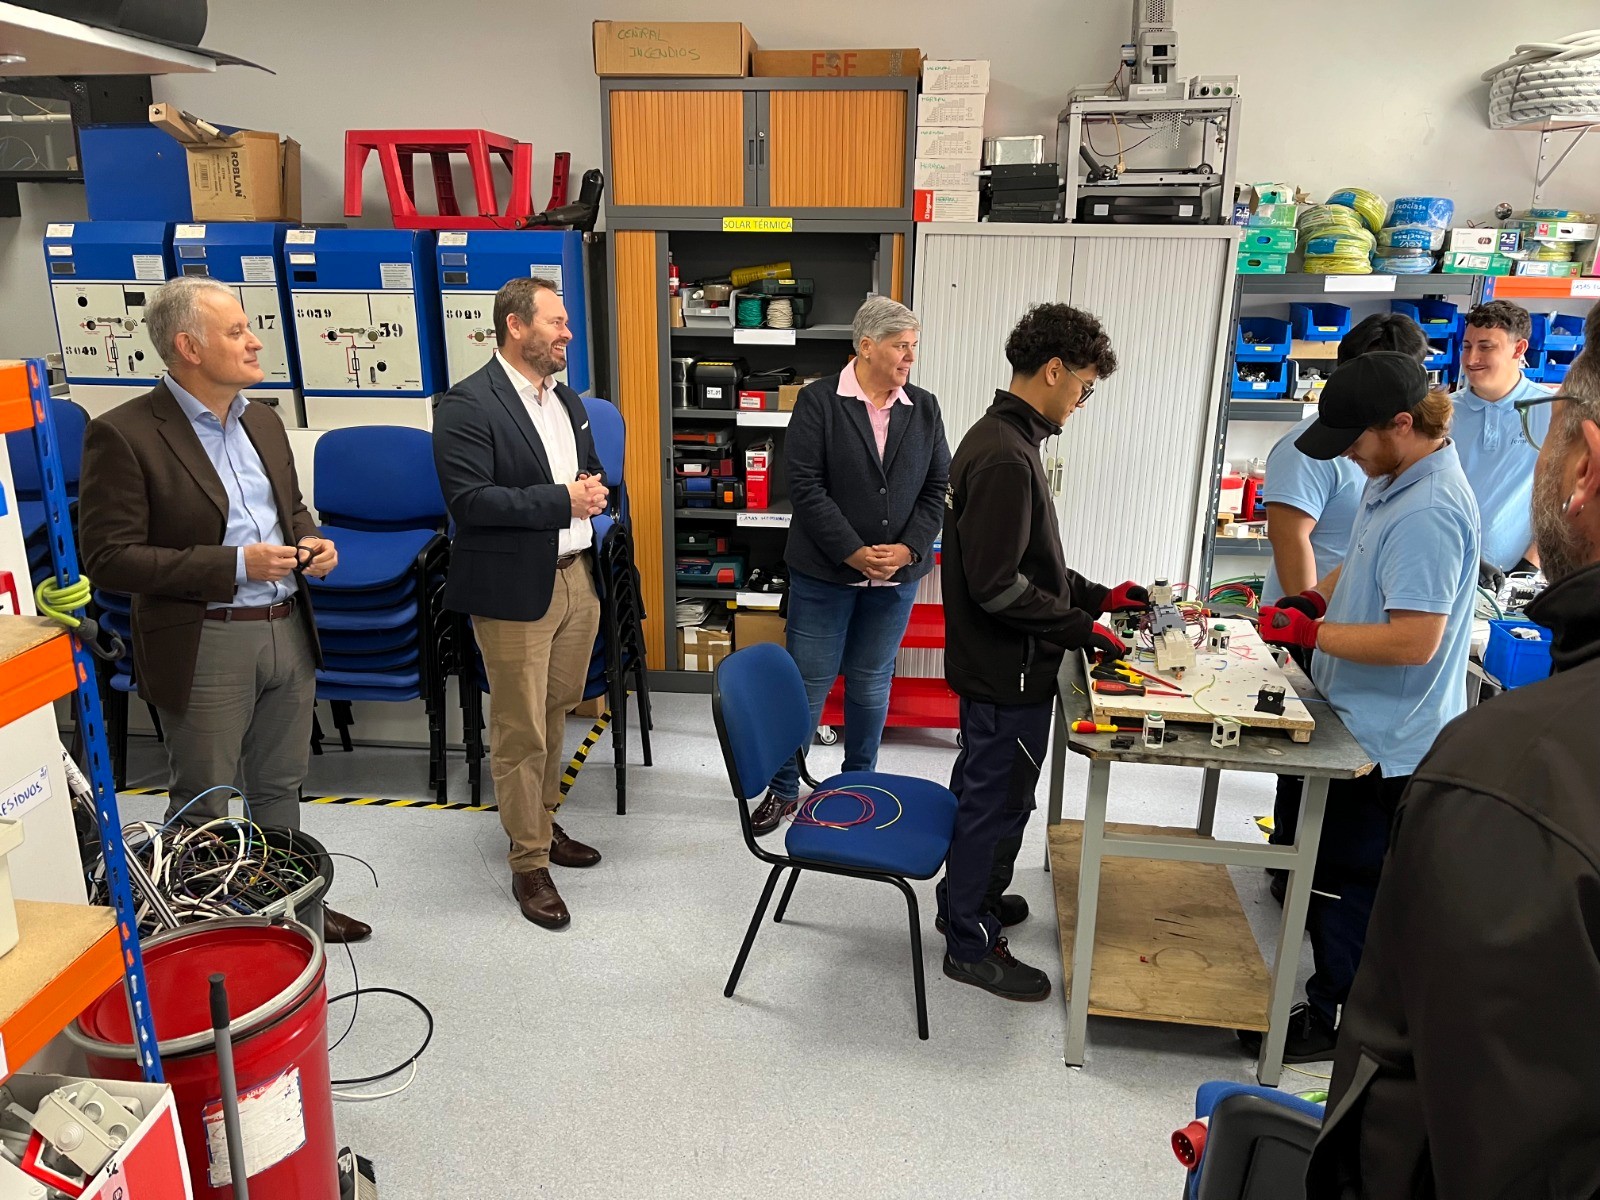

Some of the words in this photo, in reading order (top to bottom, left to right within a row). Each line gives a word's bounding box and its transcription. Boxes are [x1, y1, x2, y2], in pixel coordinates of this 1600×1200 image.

[618, 27, 668, 42] CENTRAL
[629, 46, 700, 60] INCENDIOS
[230, 151, 243, 198] ROBLAN
[724, 220, 751, 229] SOLAR
[754, 218, 792, 229] TÉRMICA
